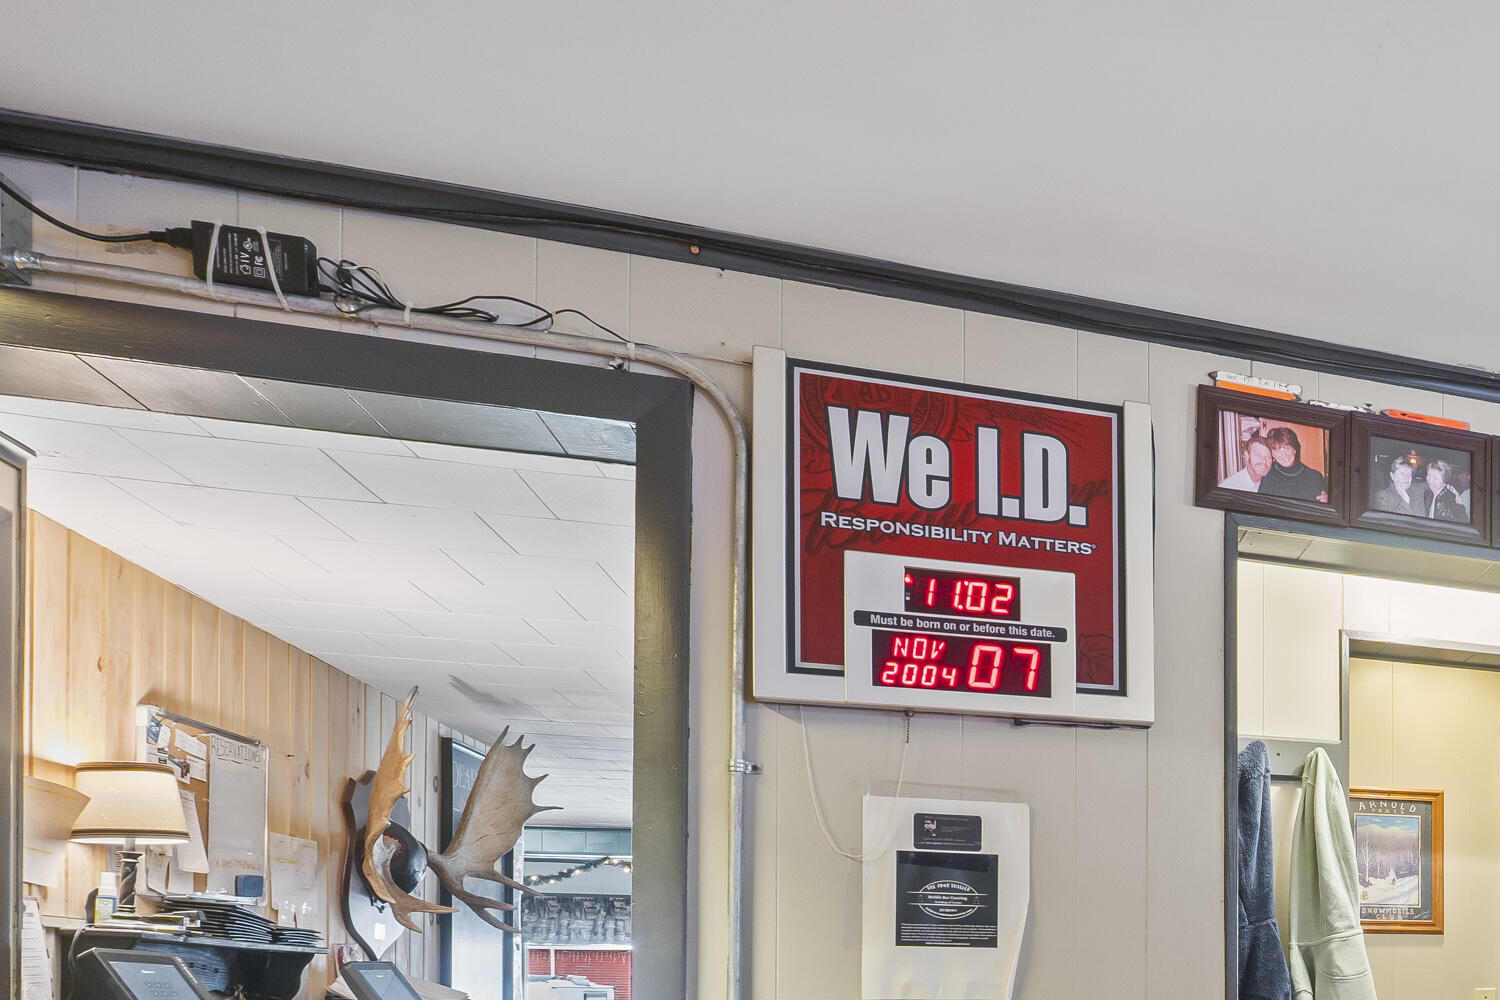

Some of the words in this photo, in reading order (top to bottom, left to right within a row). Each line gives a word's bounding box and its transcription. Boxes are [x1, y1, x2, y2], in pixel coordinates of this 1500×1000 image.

[826, 404, 952, 510] We
[976, 424, 1088, 527] I.D.
[820, 511, 994, 546] RESPONSIBILITY
[870, 614, 898, 626] Must
[900, 617, 913, 627] be
[916, 618, 940, 630] born
[943, 621, 957, 631] on
[959, 622, 971, 632] or
[973, 622, 1006, 635] before
[1008, 625, 1028, 636] this
[1030, 628, 1055, 638] date.
[893, 637, 945, 660] NOV
[882, 662, 957, 687] 2004
[968, 644, 1040, 690] 07
[1359, 801, 1417, 813] ARNOLD
[1361, 906, 1415, 915] SNOWMOBILE
